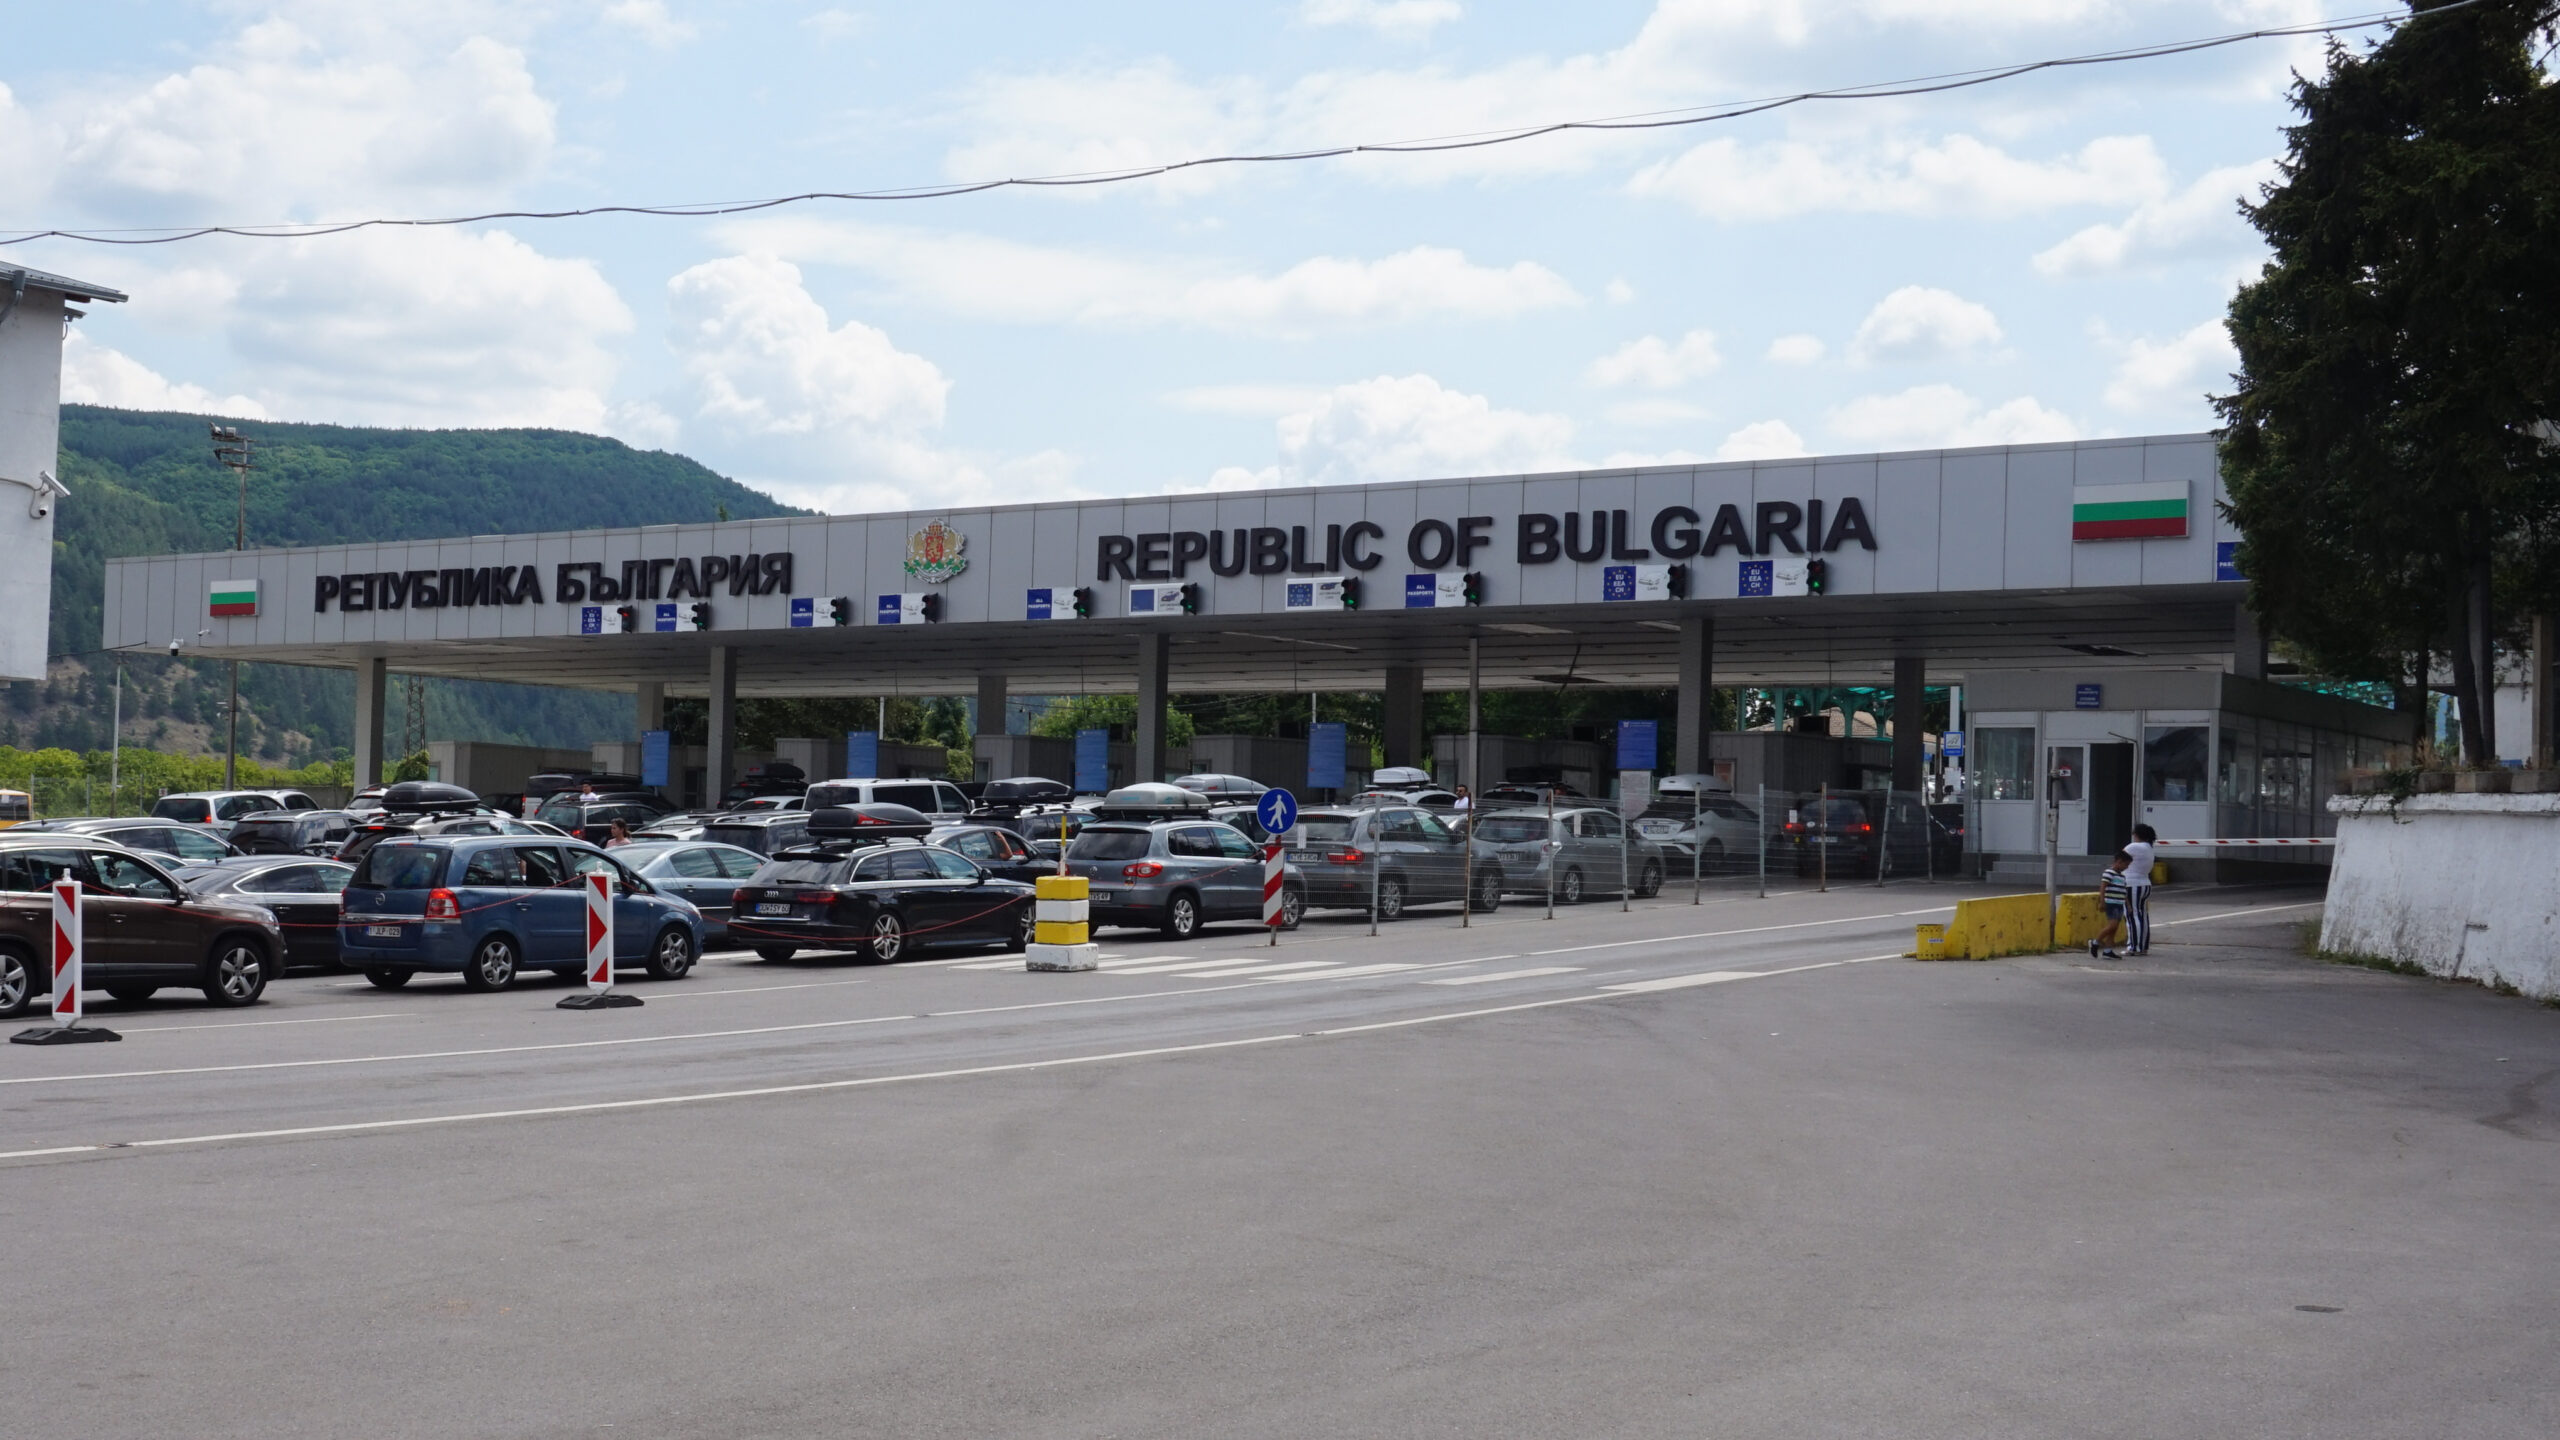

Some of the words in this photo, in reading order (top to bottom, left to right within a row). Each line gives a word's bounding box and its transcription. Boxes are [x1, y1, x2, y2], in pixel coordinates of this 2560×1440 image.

[1097, 521, 1384, 581] REPUBLIC
[1407, 516, 1494, 570] OF
[1517, 498, 1878, 568] BULGARIA
[315, 565, 544, 613] РЕПУБЛИКА
[556, 552, 793, 604] БЪЛГАРИЯ
